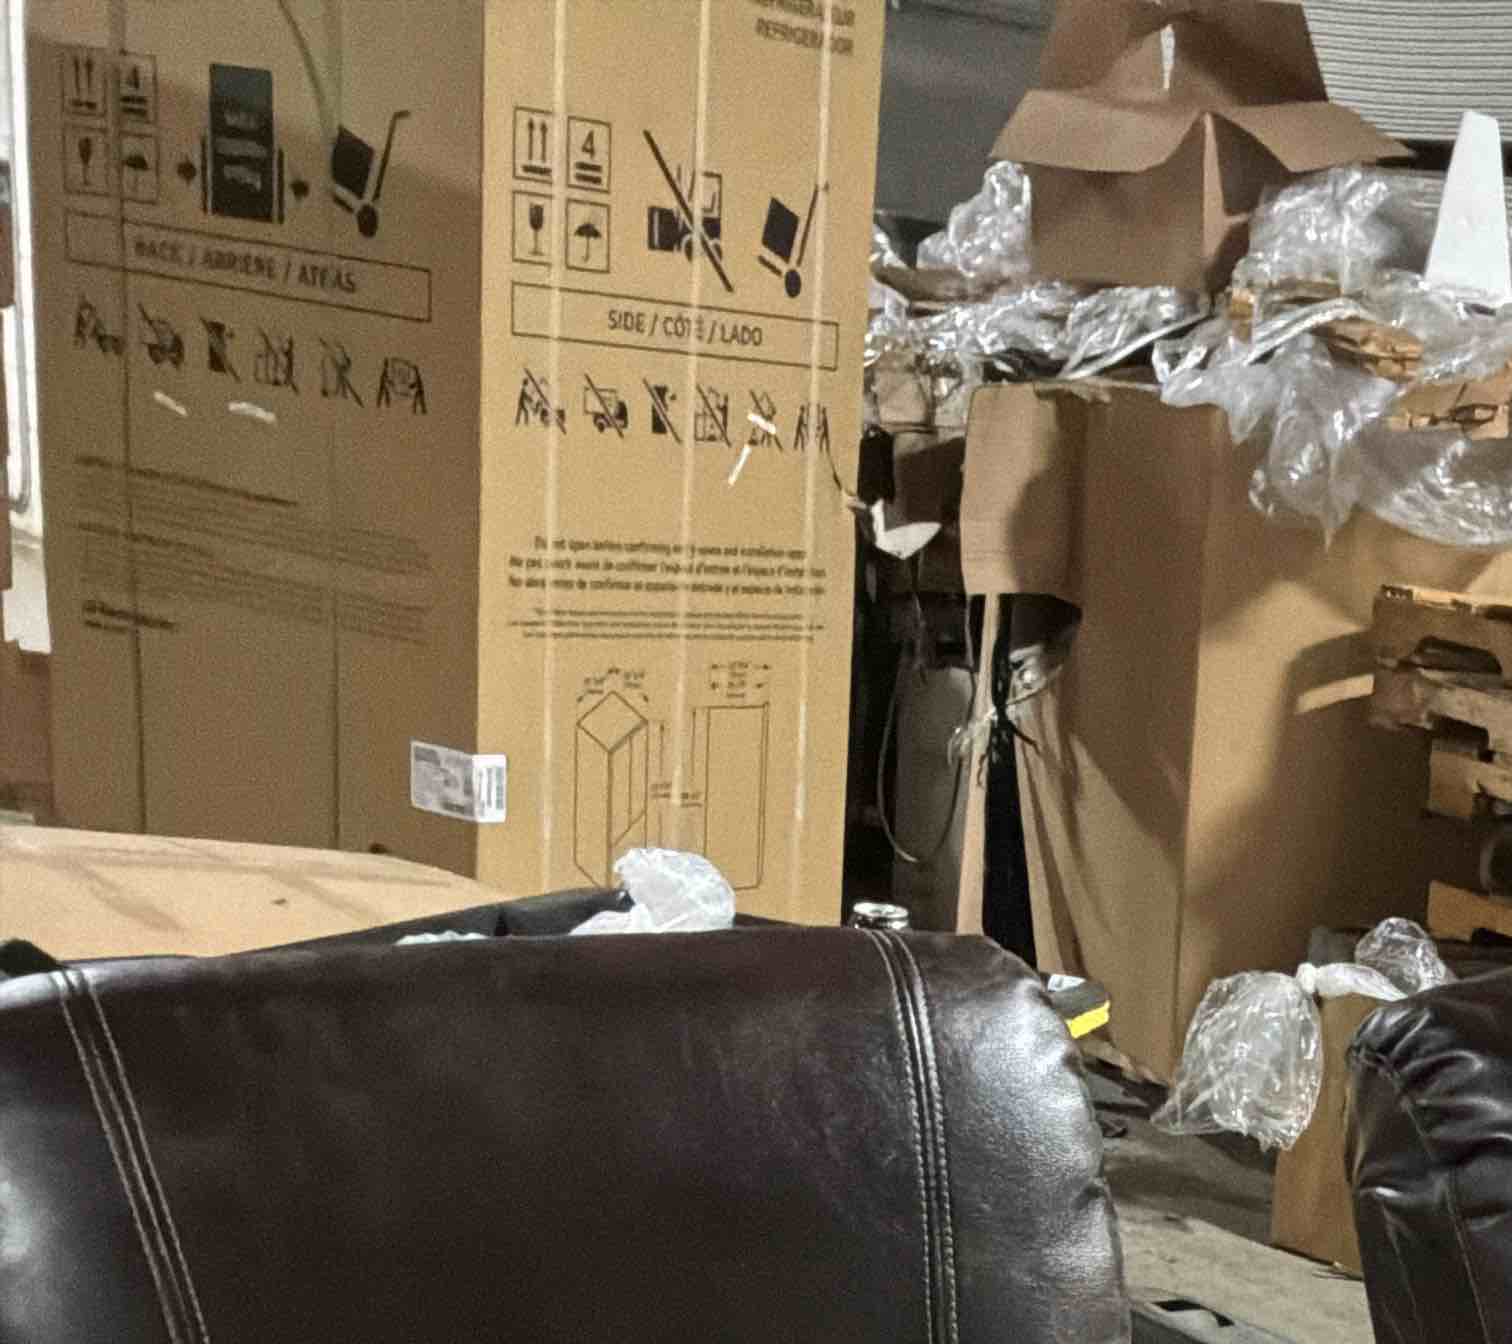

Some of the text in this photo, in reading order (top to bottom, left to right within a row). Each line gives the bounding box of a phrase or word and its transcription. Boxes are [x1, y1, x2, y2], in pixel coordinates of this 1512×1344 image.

[581, 129, 596, 159] 4
[608, 308, 646, 333] SIDE
[720, 322, 764, 347] LADO
